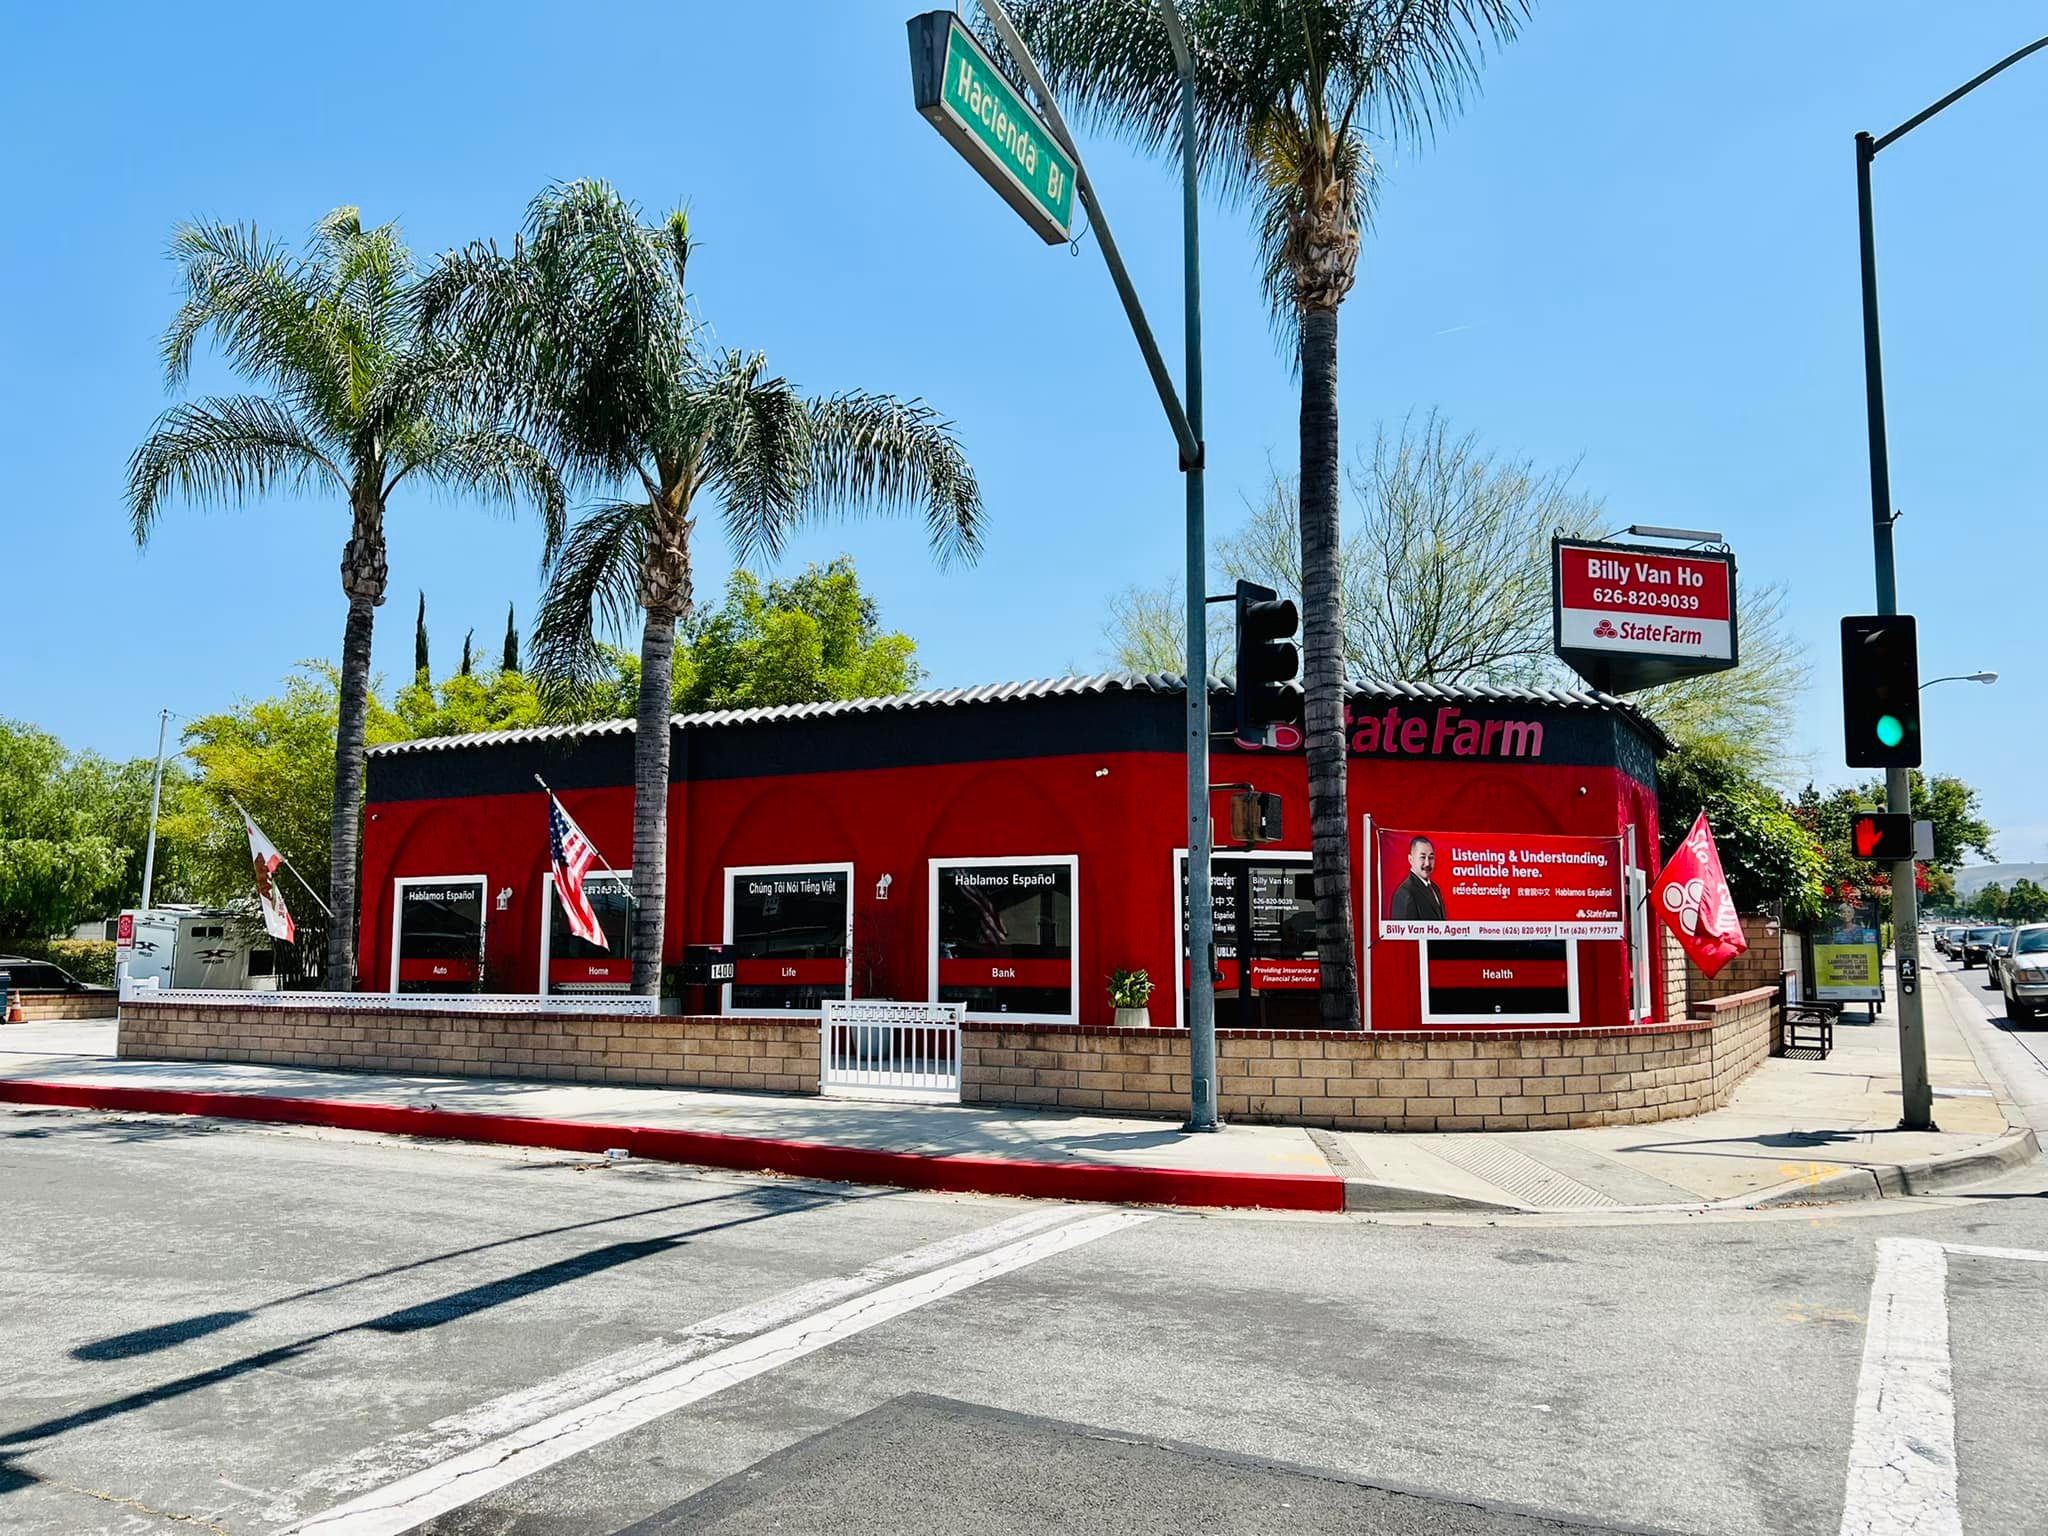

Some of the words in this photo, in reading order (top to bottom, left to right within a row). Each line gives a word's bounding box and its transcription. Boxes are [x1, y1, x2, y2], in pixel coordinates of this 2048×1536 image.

[958, 58, 1038, 176] Hacienda
[1047, 161, 1065, 205] Bl
[1588, 558, 1630, 586] Billy
[1635, 562, 1671, 584] Van
[1677, 566, 1703, 587] Ho
[1593, 588, 1699, 610] 626-820-9039
[1452, 848, 1506, 865] Listening
[1508, 850, 1518, 862] &
[1520, 850, 1608, 867] Understanding,
[1452, 864, 1509, 877] available
[1512, 865, 1543, 877] here.
[954, 873, 1009, 886] Hablamos
[1012, 873, 1055, 888] Español
[1252, 876, 1268, 886] Billy
[1269, 876, 1281, 885] Van
[1283, 877, 1293, 885] Ho
[749, 882, 773, 896] Chúng
[774, 881, 785, 893] Tôi
[786, 880, 799, 893] Nói
[800, 878, 820, 895] Tiếng
[1555, 887, 1586, 897] Hablamos
[1587, 887, 1613, 898] Español
[409, 890, 444, 900] Hablamos
[446, 889, 475, 902] Español
[1213, 911, 1235, 920] Español
[1386, 924, 1405, 935] Billy
[1408, 925, 1425, 934] Van
[1427, 925, 1442, 935] Ho,
[1444, 925, 1471, 936] Agent
[1502, 926, 1520, 935] (626)
[1571, 926, 1587, 935] (626)
[1216, 946, 1237, 957] UBLIC
[433, 965, 447, 975] Auto
[588, 966, 609, 975] Home
[712, 964, 733, 978] 1400
[781, 967, 797, 977] Life
[991, 967, 1016, 978] Bank
[1253, 966, 1282, 974] Providing
[1482, 969, 1513, 979] Health
